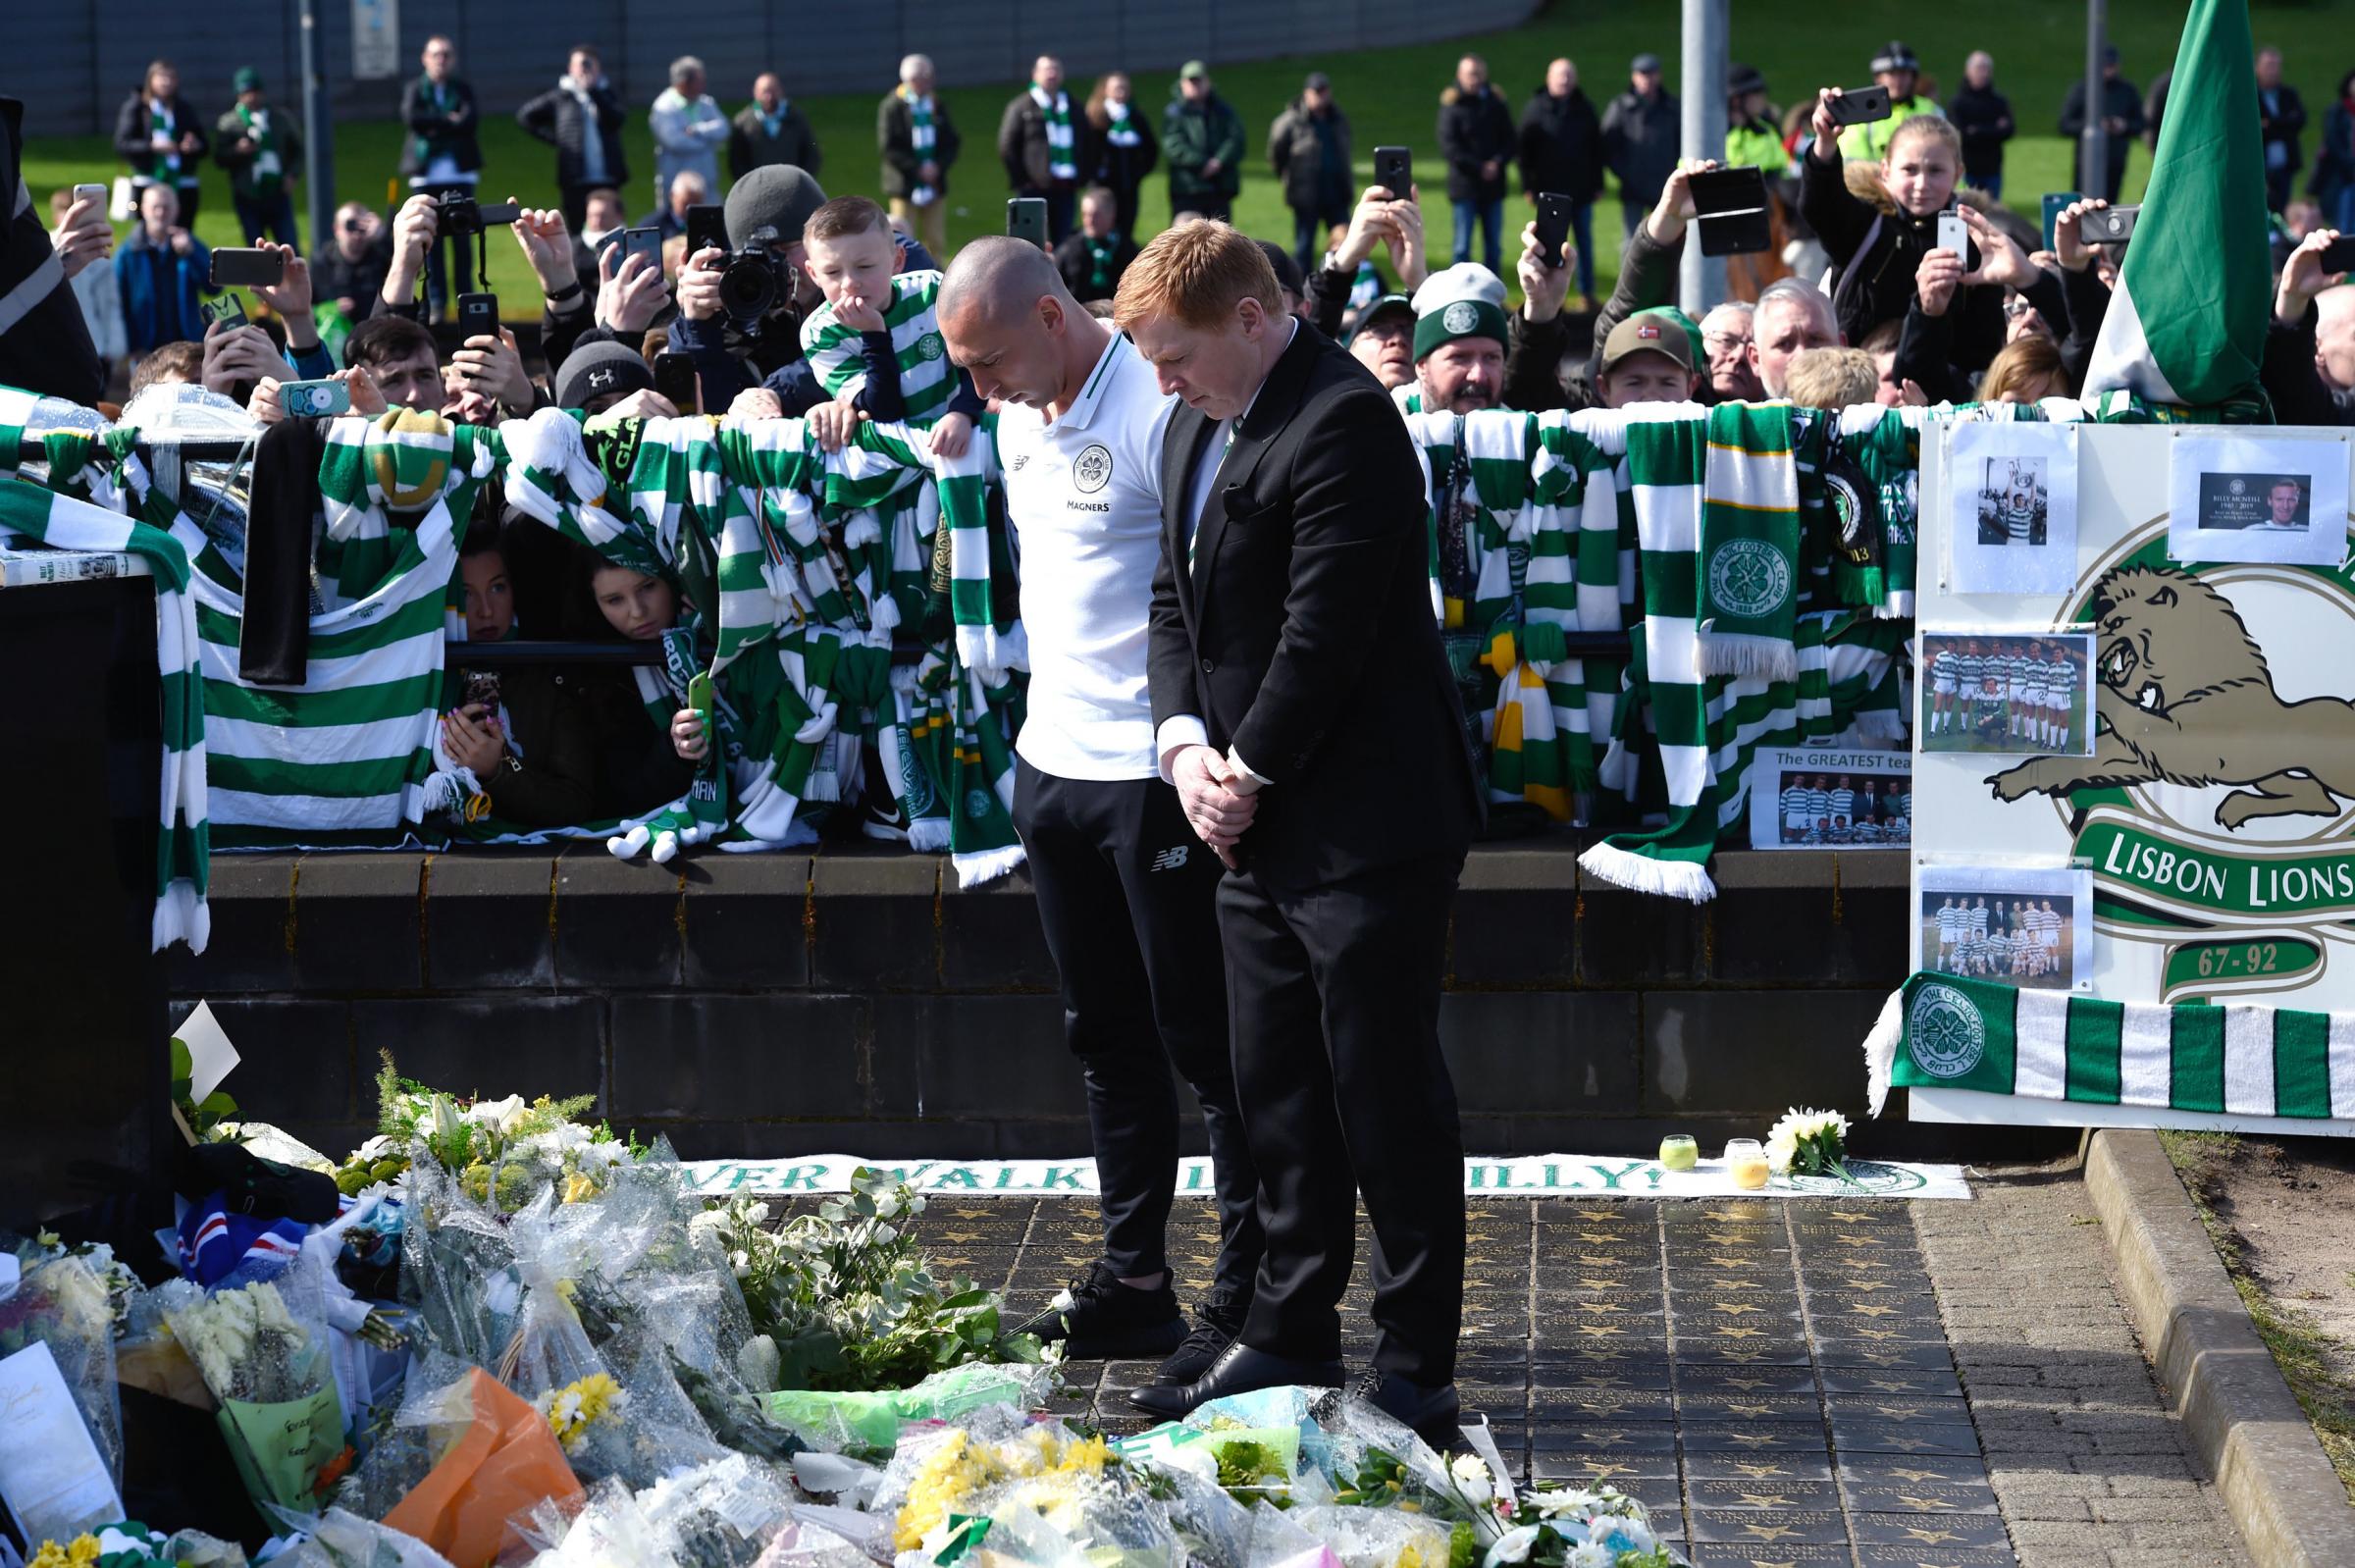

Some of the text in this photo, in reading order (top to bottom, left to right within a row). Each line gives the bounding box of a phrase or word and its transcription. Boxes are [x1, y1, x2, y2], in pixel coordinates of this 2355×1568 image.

[615, 416, 641, 469] GLA
[1067, 499, 1110, 512] MAGNERS
[1776, 753, 1911, 768] The GREATEST tea
[692, 778, 716, 802] MAN
[2104, 833, 2354, 907] LISBON LIONS
[1927, 1060, 1956, 1072] CLUB
[1468, 1162, 1663, 1188] ILLY!
